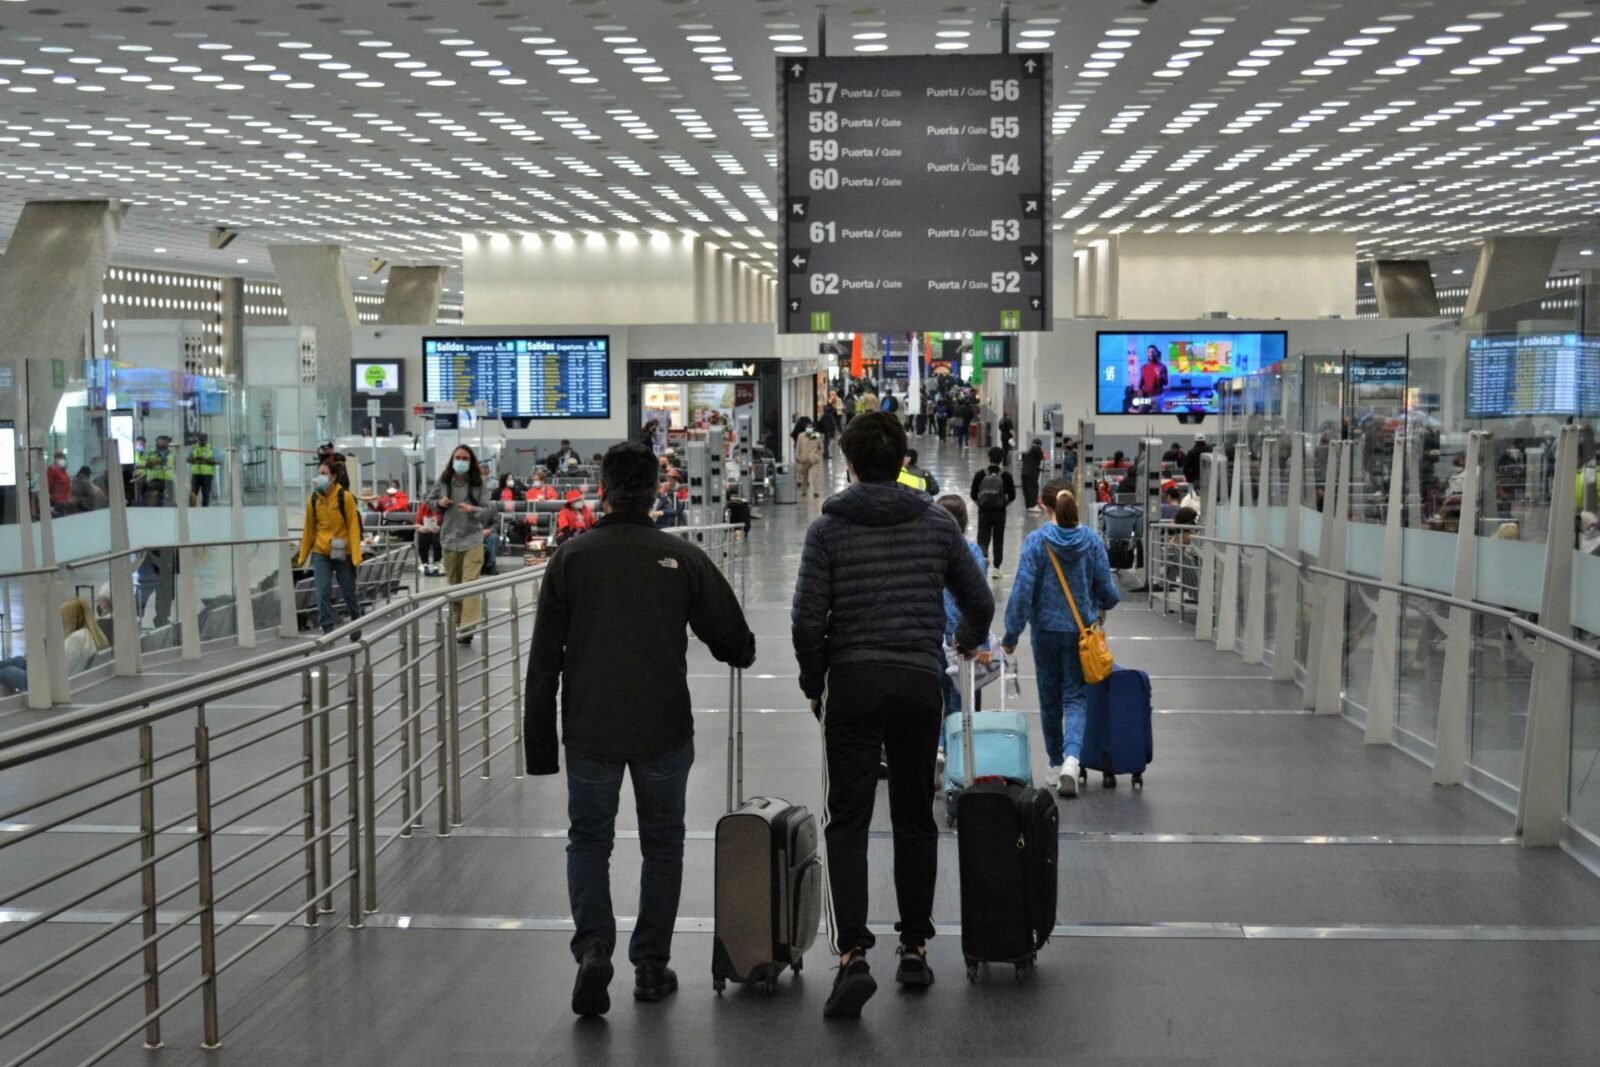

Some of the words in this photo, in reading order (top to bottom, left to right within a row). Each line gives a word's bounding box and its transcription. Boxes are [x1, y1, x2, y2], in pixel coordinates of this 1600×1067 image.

[808, 82, 838, 104] 57
[841, 89, 873, 98] Puerta
[881, 89, 902, 98] Gate
[926, 88, 959, 97] Puerta
[968, 88, 988, 97] Gate
[990, 79, 1020, 101] 56
[808, 111, 839, 133] 58
[841, 119, 873, 128] Puerta
[881, 119, 902, 128] Gate
[927, 126, 959, 136] Puerta
[968, 126, 988, 135] Gate
[990, 117, 1020, 139] 55
[808, 139, 839, 162] 59
[841, 148, 874, 158] Puerta
[882, 148, 902, 157] Gate
[927, 163, 960, 173] Puerta
[968, 163, 988, 173] Gate
[990, 154, 1020, 176] 54
[808, 168, 839, 190] 60
[841, 177, 874, 187] Puerta
[882, 178, 902, 187] Gate
[809, 221, 836, 243] 61
[842, 229, 874, 239] Puerta
[882, 229, 902, 239] Gate
[928, 228, 960, 238] Puerta
[968, 229, 989, 238] Gate
[991, 219, 1020, 242] 53
[810, 273, 839, 295] 62
[842, 280, 874, 290] Puerta
[882, 280, 903, 290] Gate
[928, 280, 960, 290] Puerta
[968, 281, 989, 290] Gate
[991, 271, 1020, 293] 52
[437, 342, 464, 352] Salidas
[527, 341, 555, 351] Salidas
[653, 369, 684, 377] MEXICO
